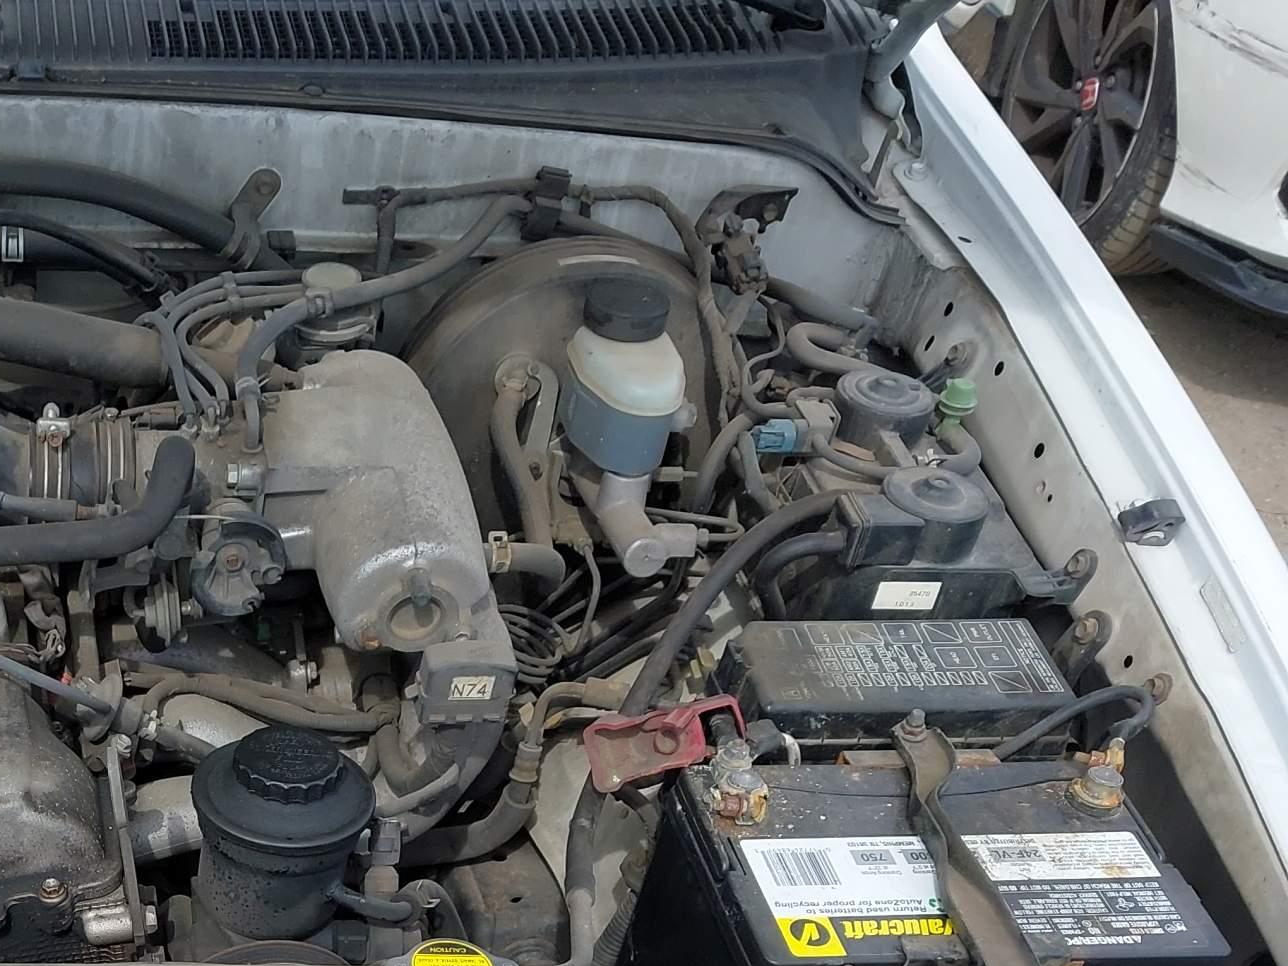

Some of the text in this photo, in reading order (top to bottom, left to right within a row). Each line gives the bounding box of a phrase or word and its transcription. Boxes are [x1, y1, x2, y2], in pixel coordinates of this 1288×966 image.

[452, 683, 489, 697] N74
[860, 852, 888, 862] 750
[910, 852, 929, 861] 00
[774, 900, 820, 908] recycling
[822, 899, 856, 907] proper
